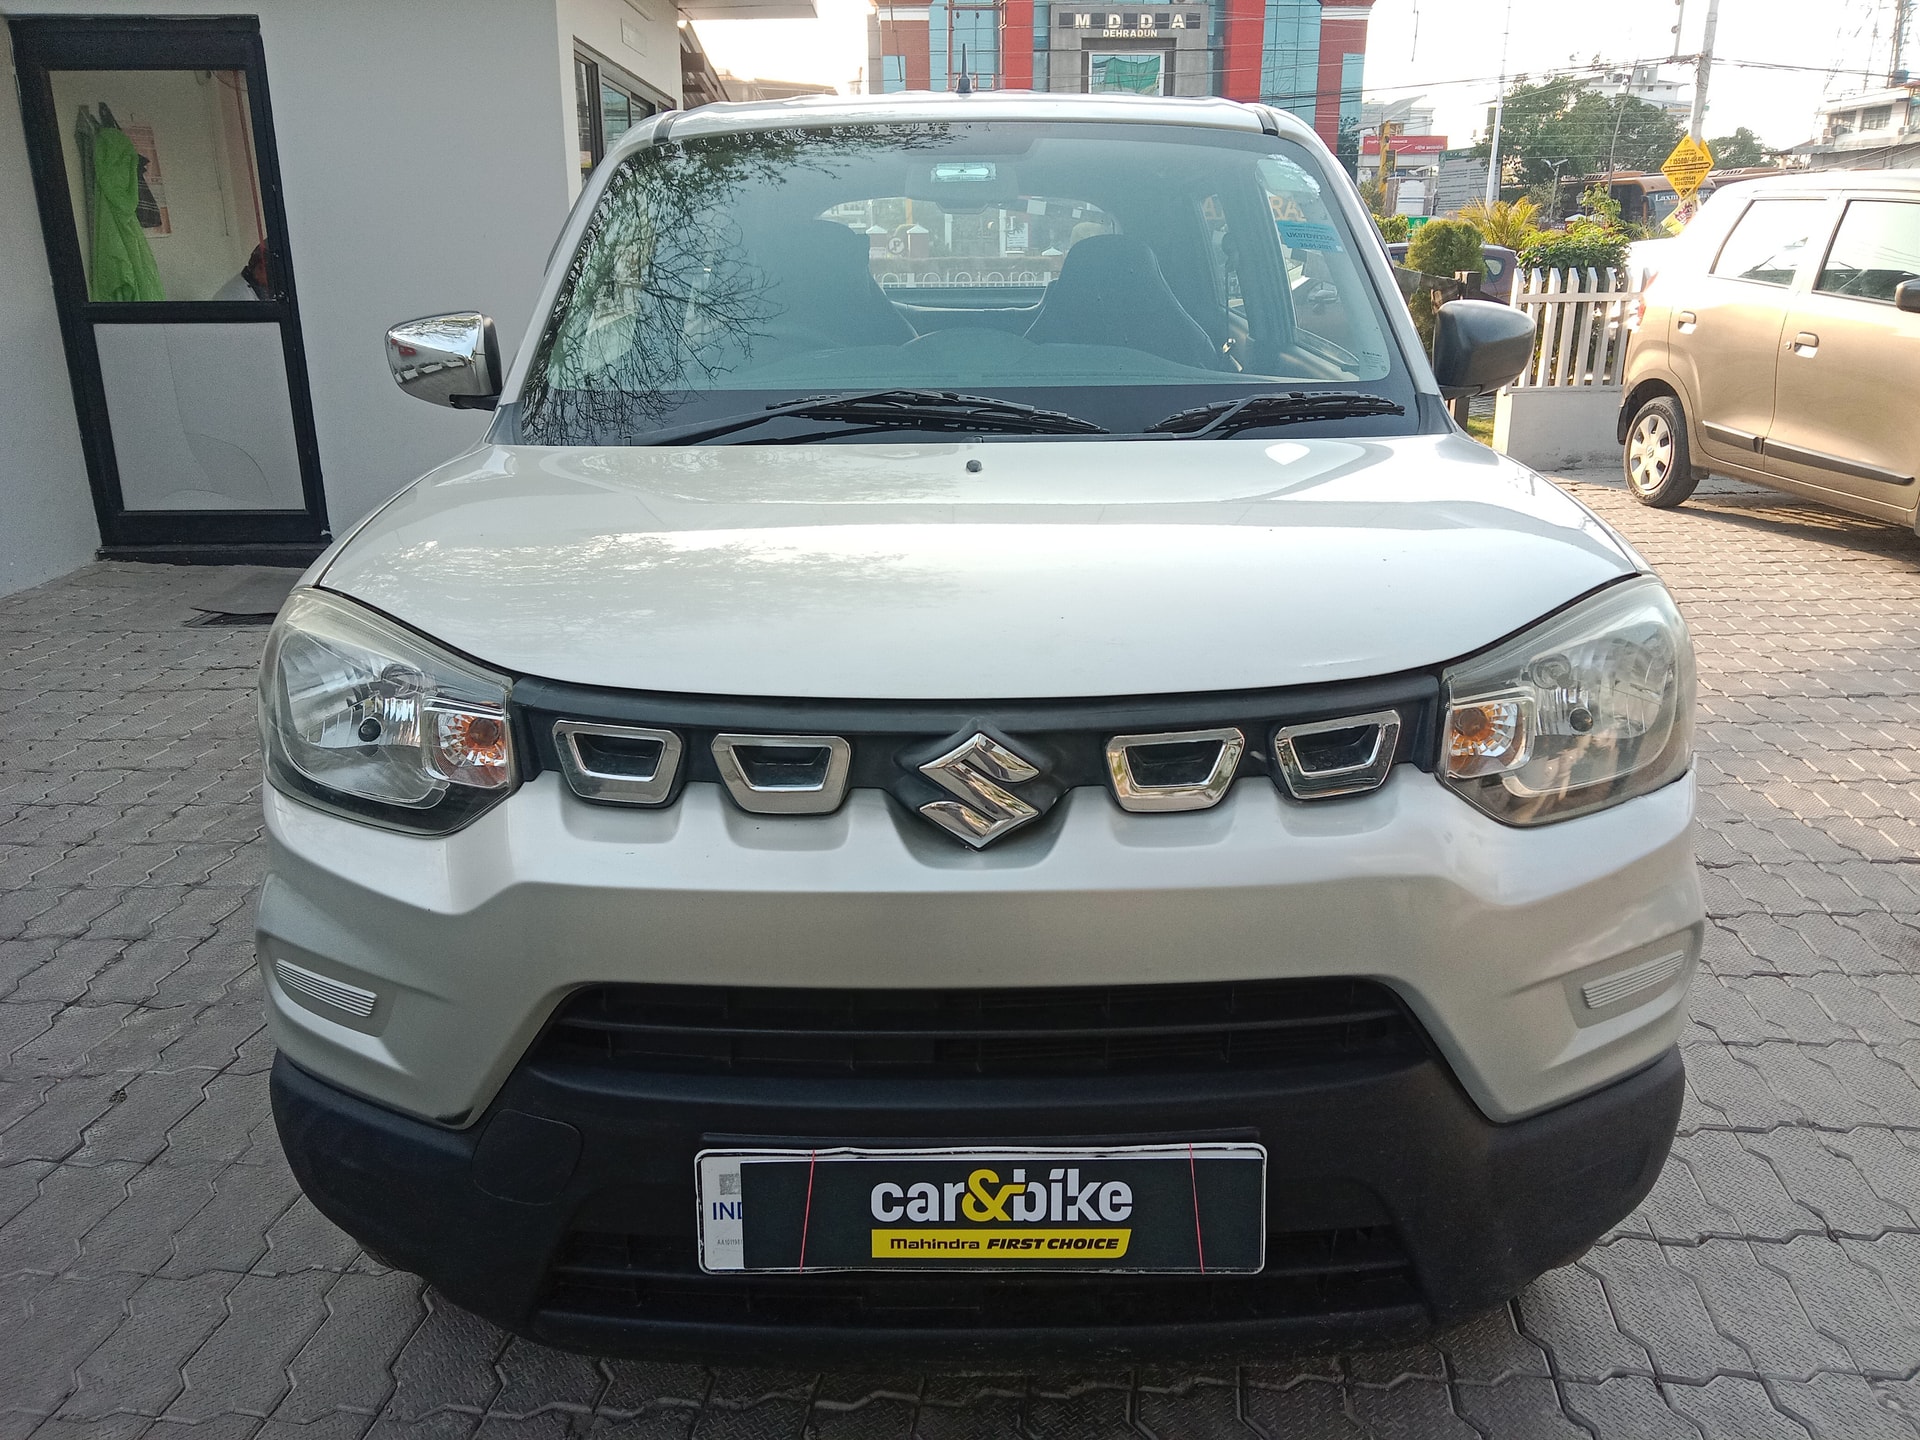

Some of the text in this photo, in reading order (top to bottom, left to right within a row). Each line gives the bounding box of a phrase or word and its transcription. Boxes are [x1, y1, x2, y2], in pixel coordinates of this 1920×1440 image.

[1102, 29, 1158, 38] DEHRADUN
[871, 1169, 1133, 1222] car&bike
[890, 1238, 1120, 1250] Mahindra FIRST CHOICE
